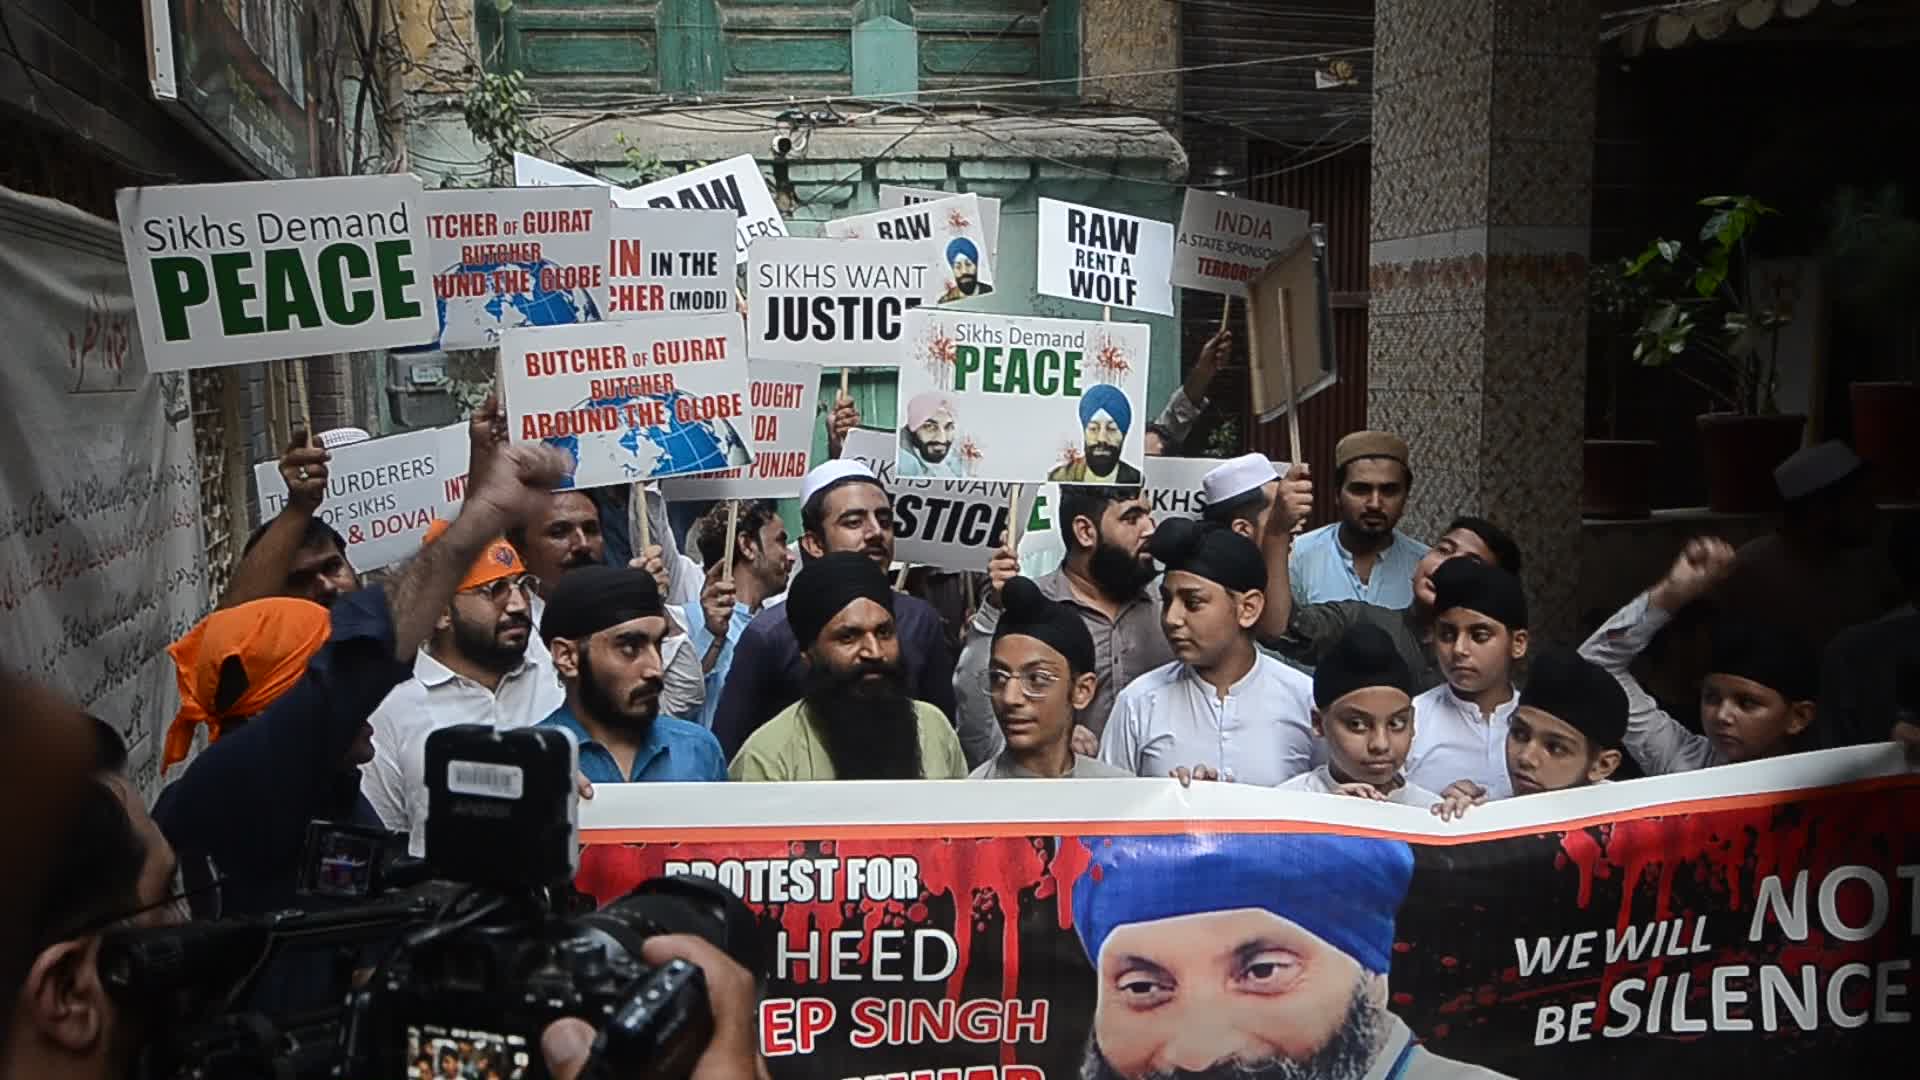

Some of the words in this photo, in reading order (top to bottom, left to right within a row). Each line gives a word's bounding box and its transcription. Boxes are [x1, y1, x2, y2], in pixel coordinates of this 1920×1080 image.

[143, 213, 245, 252] Sikhs
[257, 202, 410, 245] Demand
[426, 213, 498, 239] TCHER
[503, 221, 519, 236] OF
[523, 209, 593, 235] GUJRAT
[1068, 208, 1139, 255] RAW
[1179, 233, 1188, 244] A
[1190, 234, 1225, 253] STATE
[1215, 208, 1273, 241] INDIA
[462, 242, 542, 265] BUTCHER
[651, 252, 672, 276] IN
[681, 252, 718, 277] THE
[1075, 249, 1115, 273] RENT
[1120, 256, 1131, 276] A
[150, 239, 422, 342] PEACE
[492, 269, 530, 295] THE
[541, 265, 602, 292] GLOBE
[759, 263, 836, 289] SIKHS
[846, 265, 928, 290] WANT
[1069, 269, 1138, 307] WOLF
[669, 290, 728, 311] (MODI)
[763, 296, 923, 342] JUSTIC
[956, 323, 1003, 344] Sikhs
[1009, 327, 1085, 348] Demand
[525, 345, 627, 378] BUTCHER
[633, 352, 648, 368] OF
[653, 337, 727, 365] GUJRAT
[954, 344, 1083, 397] PEACE
[591, 373, 675, 400] BUTCHER
[522, 404, 619, 441] AROUND
[624, 401, 665, 427] THE
[676, 393, 743, 424] GLOBE
[325, 456, 434, 500] URDERERS
[320, 508, 342, 526] OF
[349, 494, 397, 520] SIKHS
[348, 524, 366, 545] &
[846, 857, 919, 901] FOR
[776, 928, 959, 982] HEED
[1514, 931, 1598, 978] WE
[1604, 915, 1712, 965] WILL
[1534, 1001, 1597, 1046] BE
[1602, 959, 1912, 1039] SILENCE
[851, 999, 1049, 1048] SINGH
